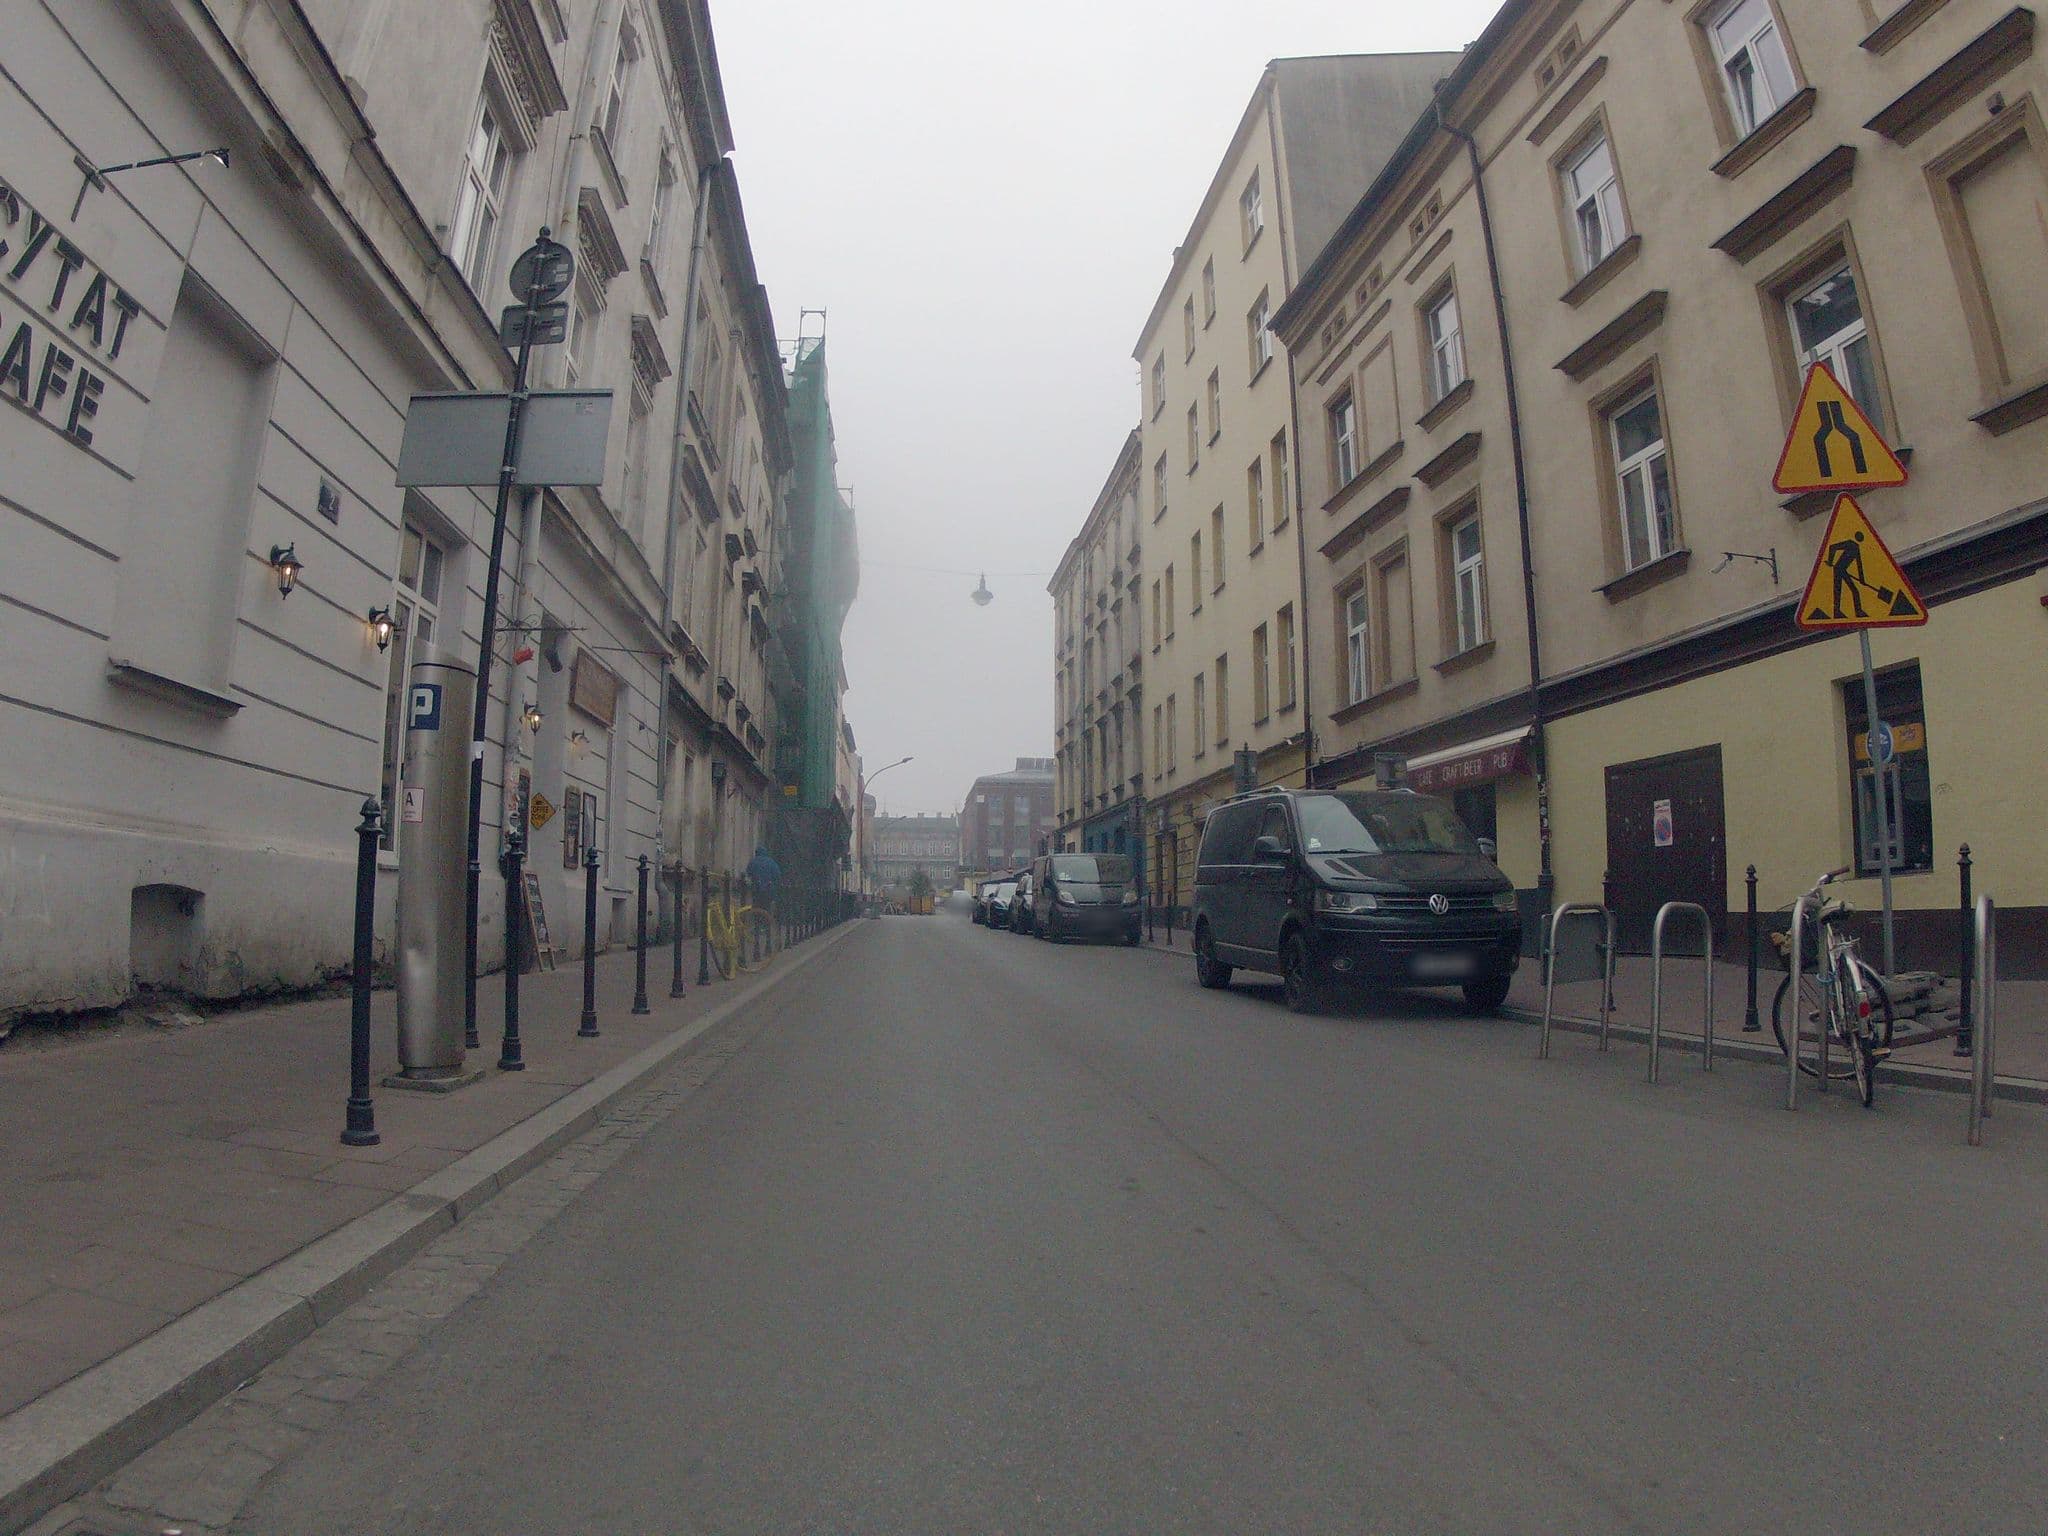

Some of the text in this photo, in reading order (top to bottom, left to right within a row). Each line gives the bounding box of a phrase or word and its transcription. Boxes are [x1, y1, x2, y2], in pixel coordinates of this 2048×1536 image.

[0, 319, 105, 445] AFE
[410, 688, 434, 727] P
[405, 791, 414, 806] A
